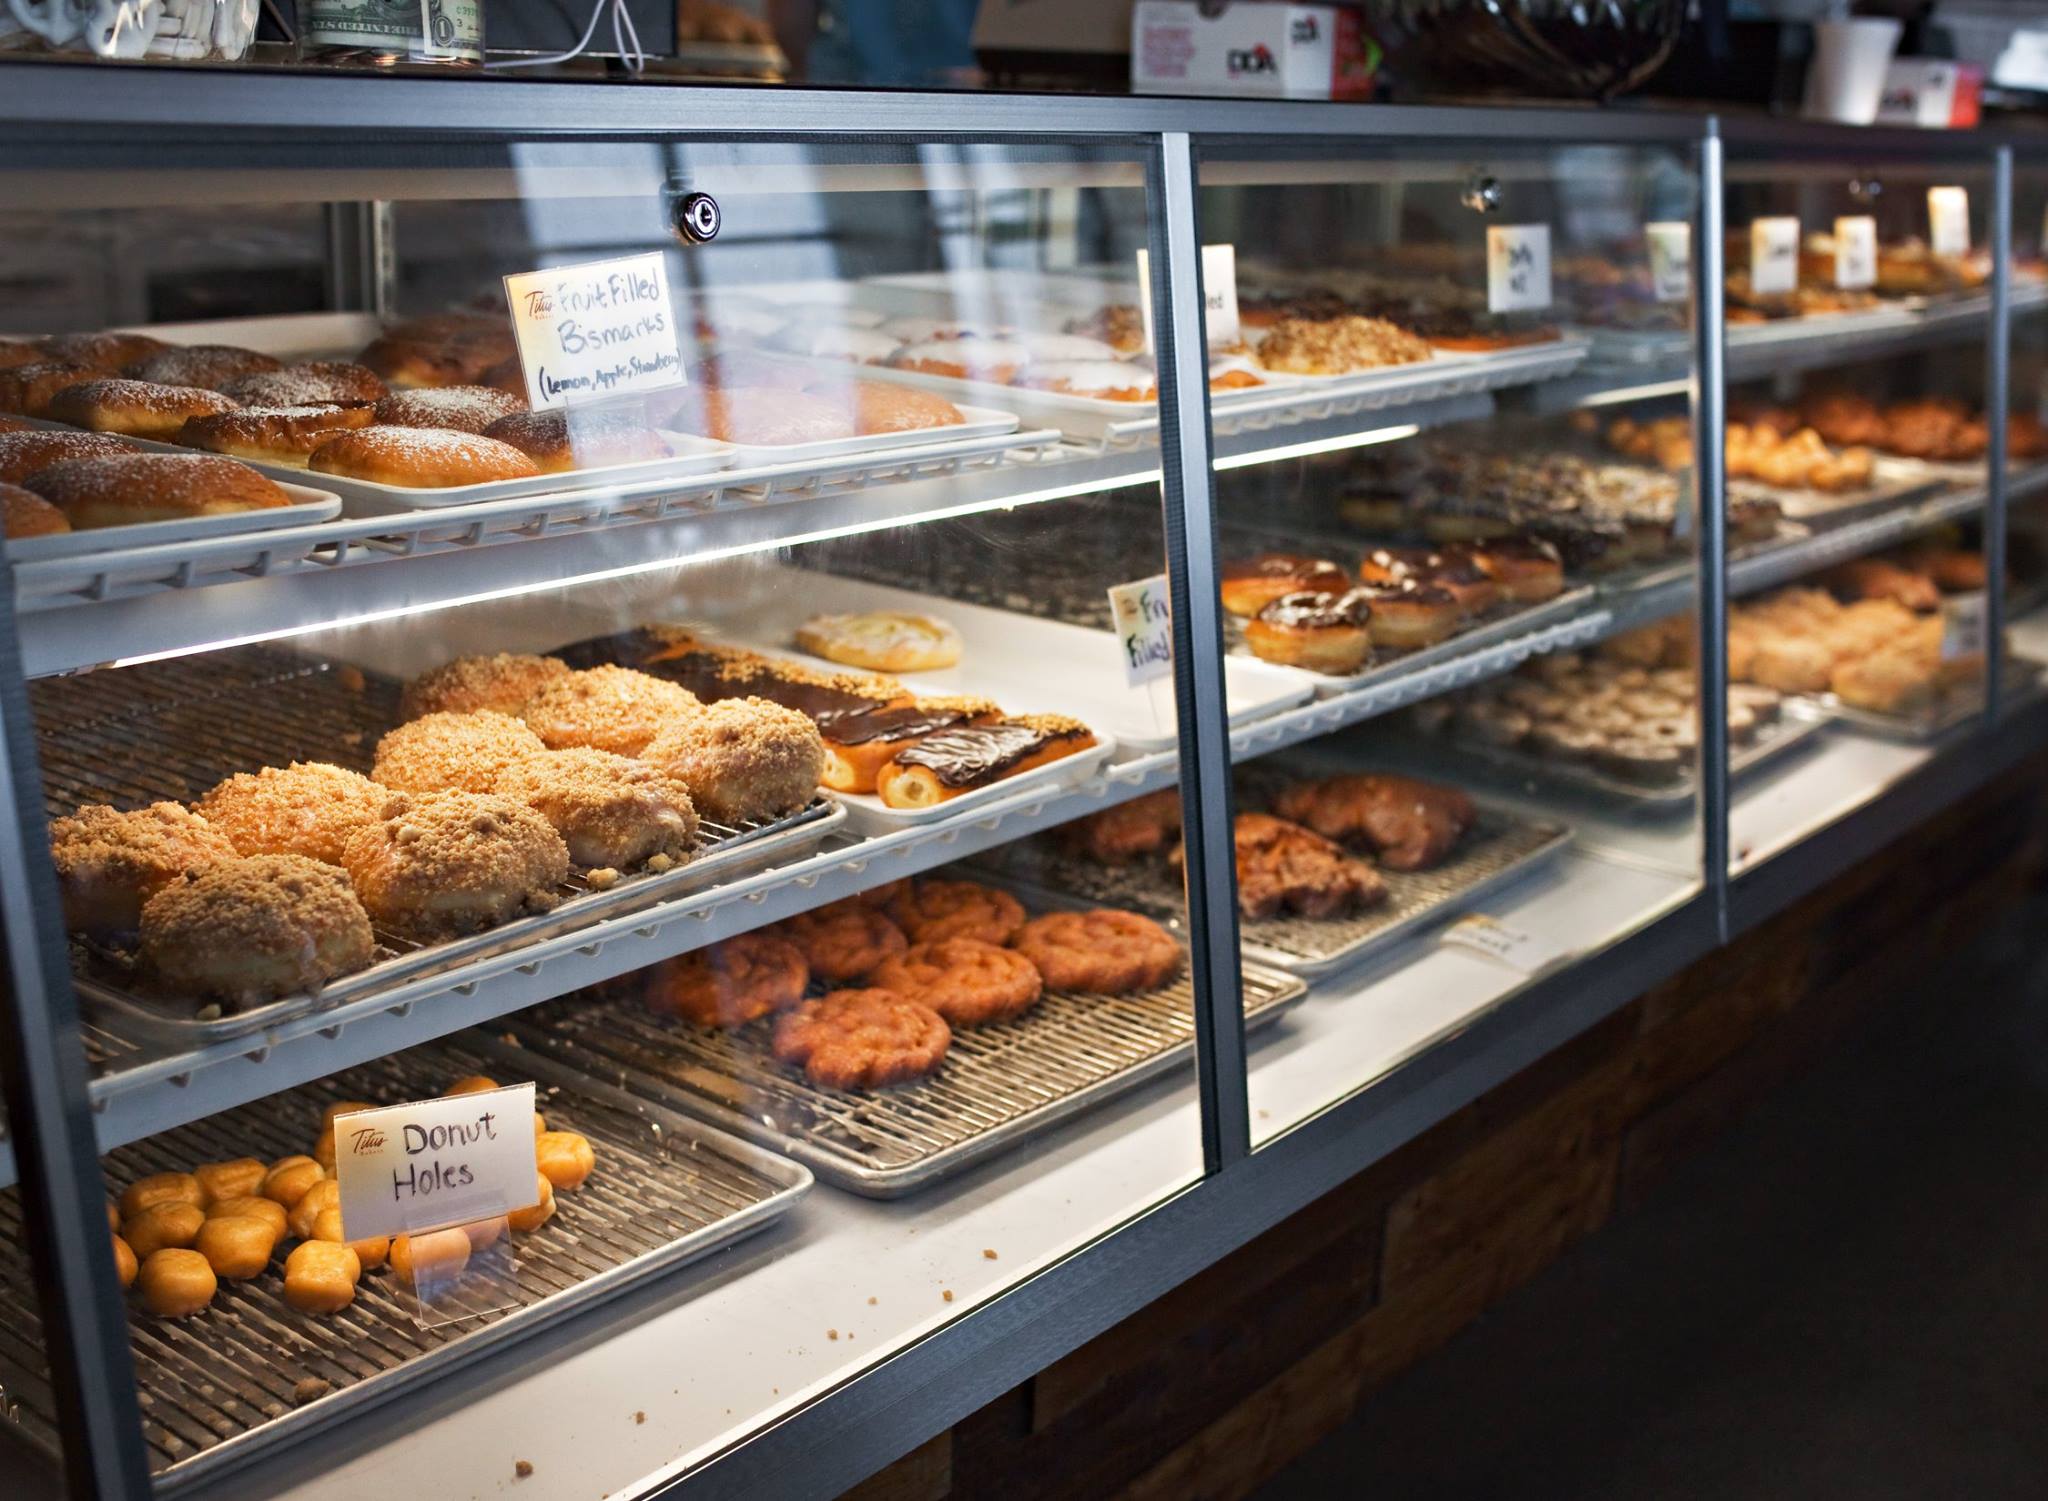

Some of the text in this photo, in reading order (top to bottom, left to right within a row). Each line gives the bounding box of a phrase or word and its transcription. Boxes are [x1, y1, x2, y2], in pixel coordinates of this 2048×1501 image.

[338, 21, 391, 34] UNITED
[558, 267, 659, 313] Fruit Filled
[557, 318, 665, 354] Bismarks
[350, 1128, 388, 1154] Titus
[402, 1111, 497, 1155] Donut
[393, 1160, 474, 1201] Holes
